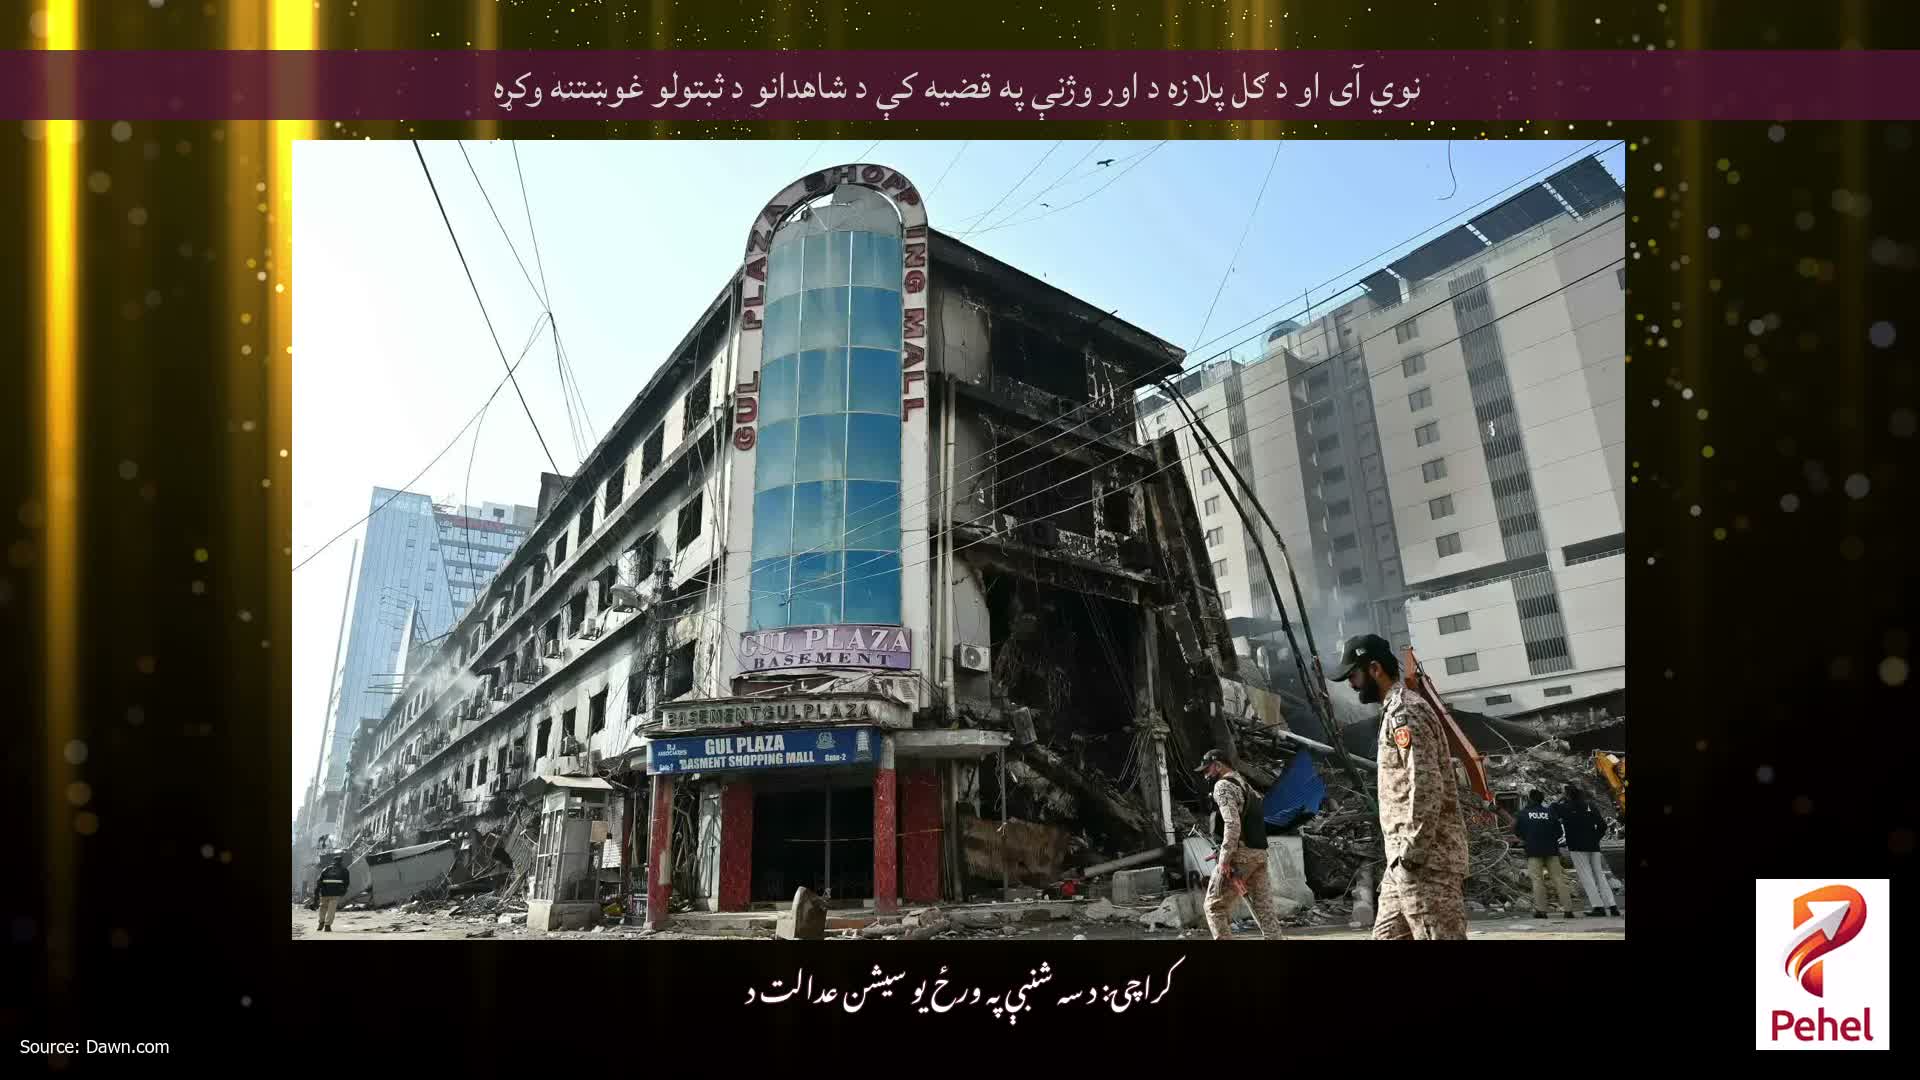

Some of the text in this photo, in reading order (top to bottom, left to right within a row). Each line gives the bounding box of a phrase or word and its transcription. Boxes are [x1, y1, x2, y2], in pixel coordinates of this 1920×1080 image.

[741, 202, 790, 333] PLAZA
[902, 307, 926, 423] MALL
[733, 370, 760, 452] GUL
[740, 627, 912, 658] GUL PLAZA
[753, 651, 892, 670] BASEMENT
[705, 733, 786, 756] GUL PLAZA
[728, 752, 784, 767] SHOPPING
[785, 750, 816, 764] MALL
[1528, 811, 1550, 820] POLICE
